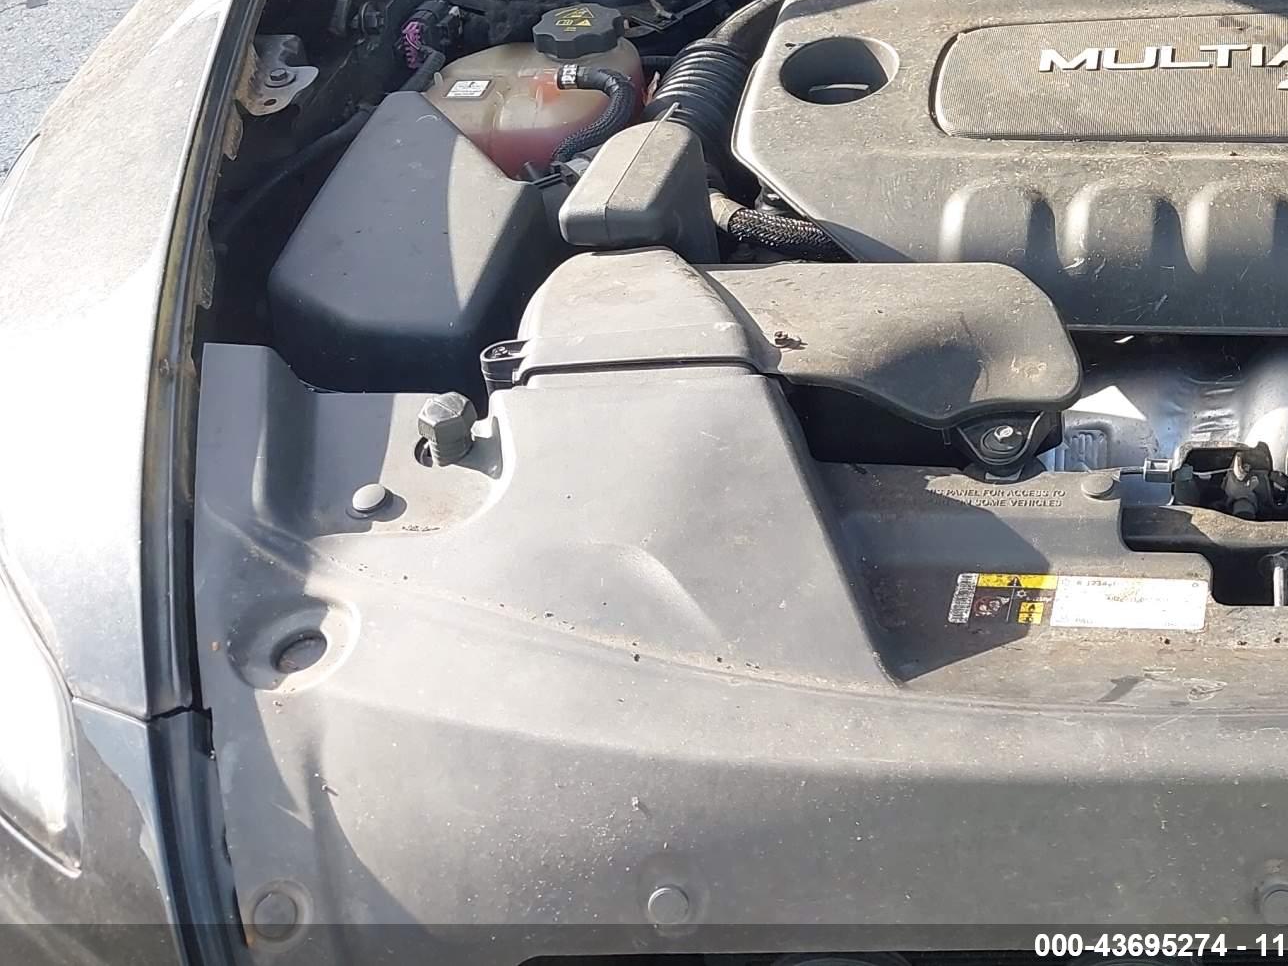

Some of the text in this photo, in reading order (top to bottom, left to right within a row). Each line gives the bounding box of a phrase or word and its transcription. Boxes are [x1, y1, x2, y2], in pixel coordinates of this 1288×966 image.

[946, 489, 980, 497] PANEL
[983, 489, 1004, 497] FOR
[1052, 489, 1066, 497] TO
[975, 499, 1007, 507] SOME
[1009, 499, 1063, 507] VEHICLES
